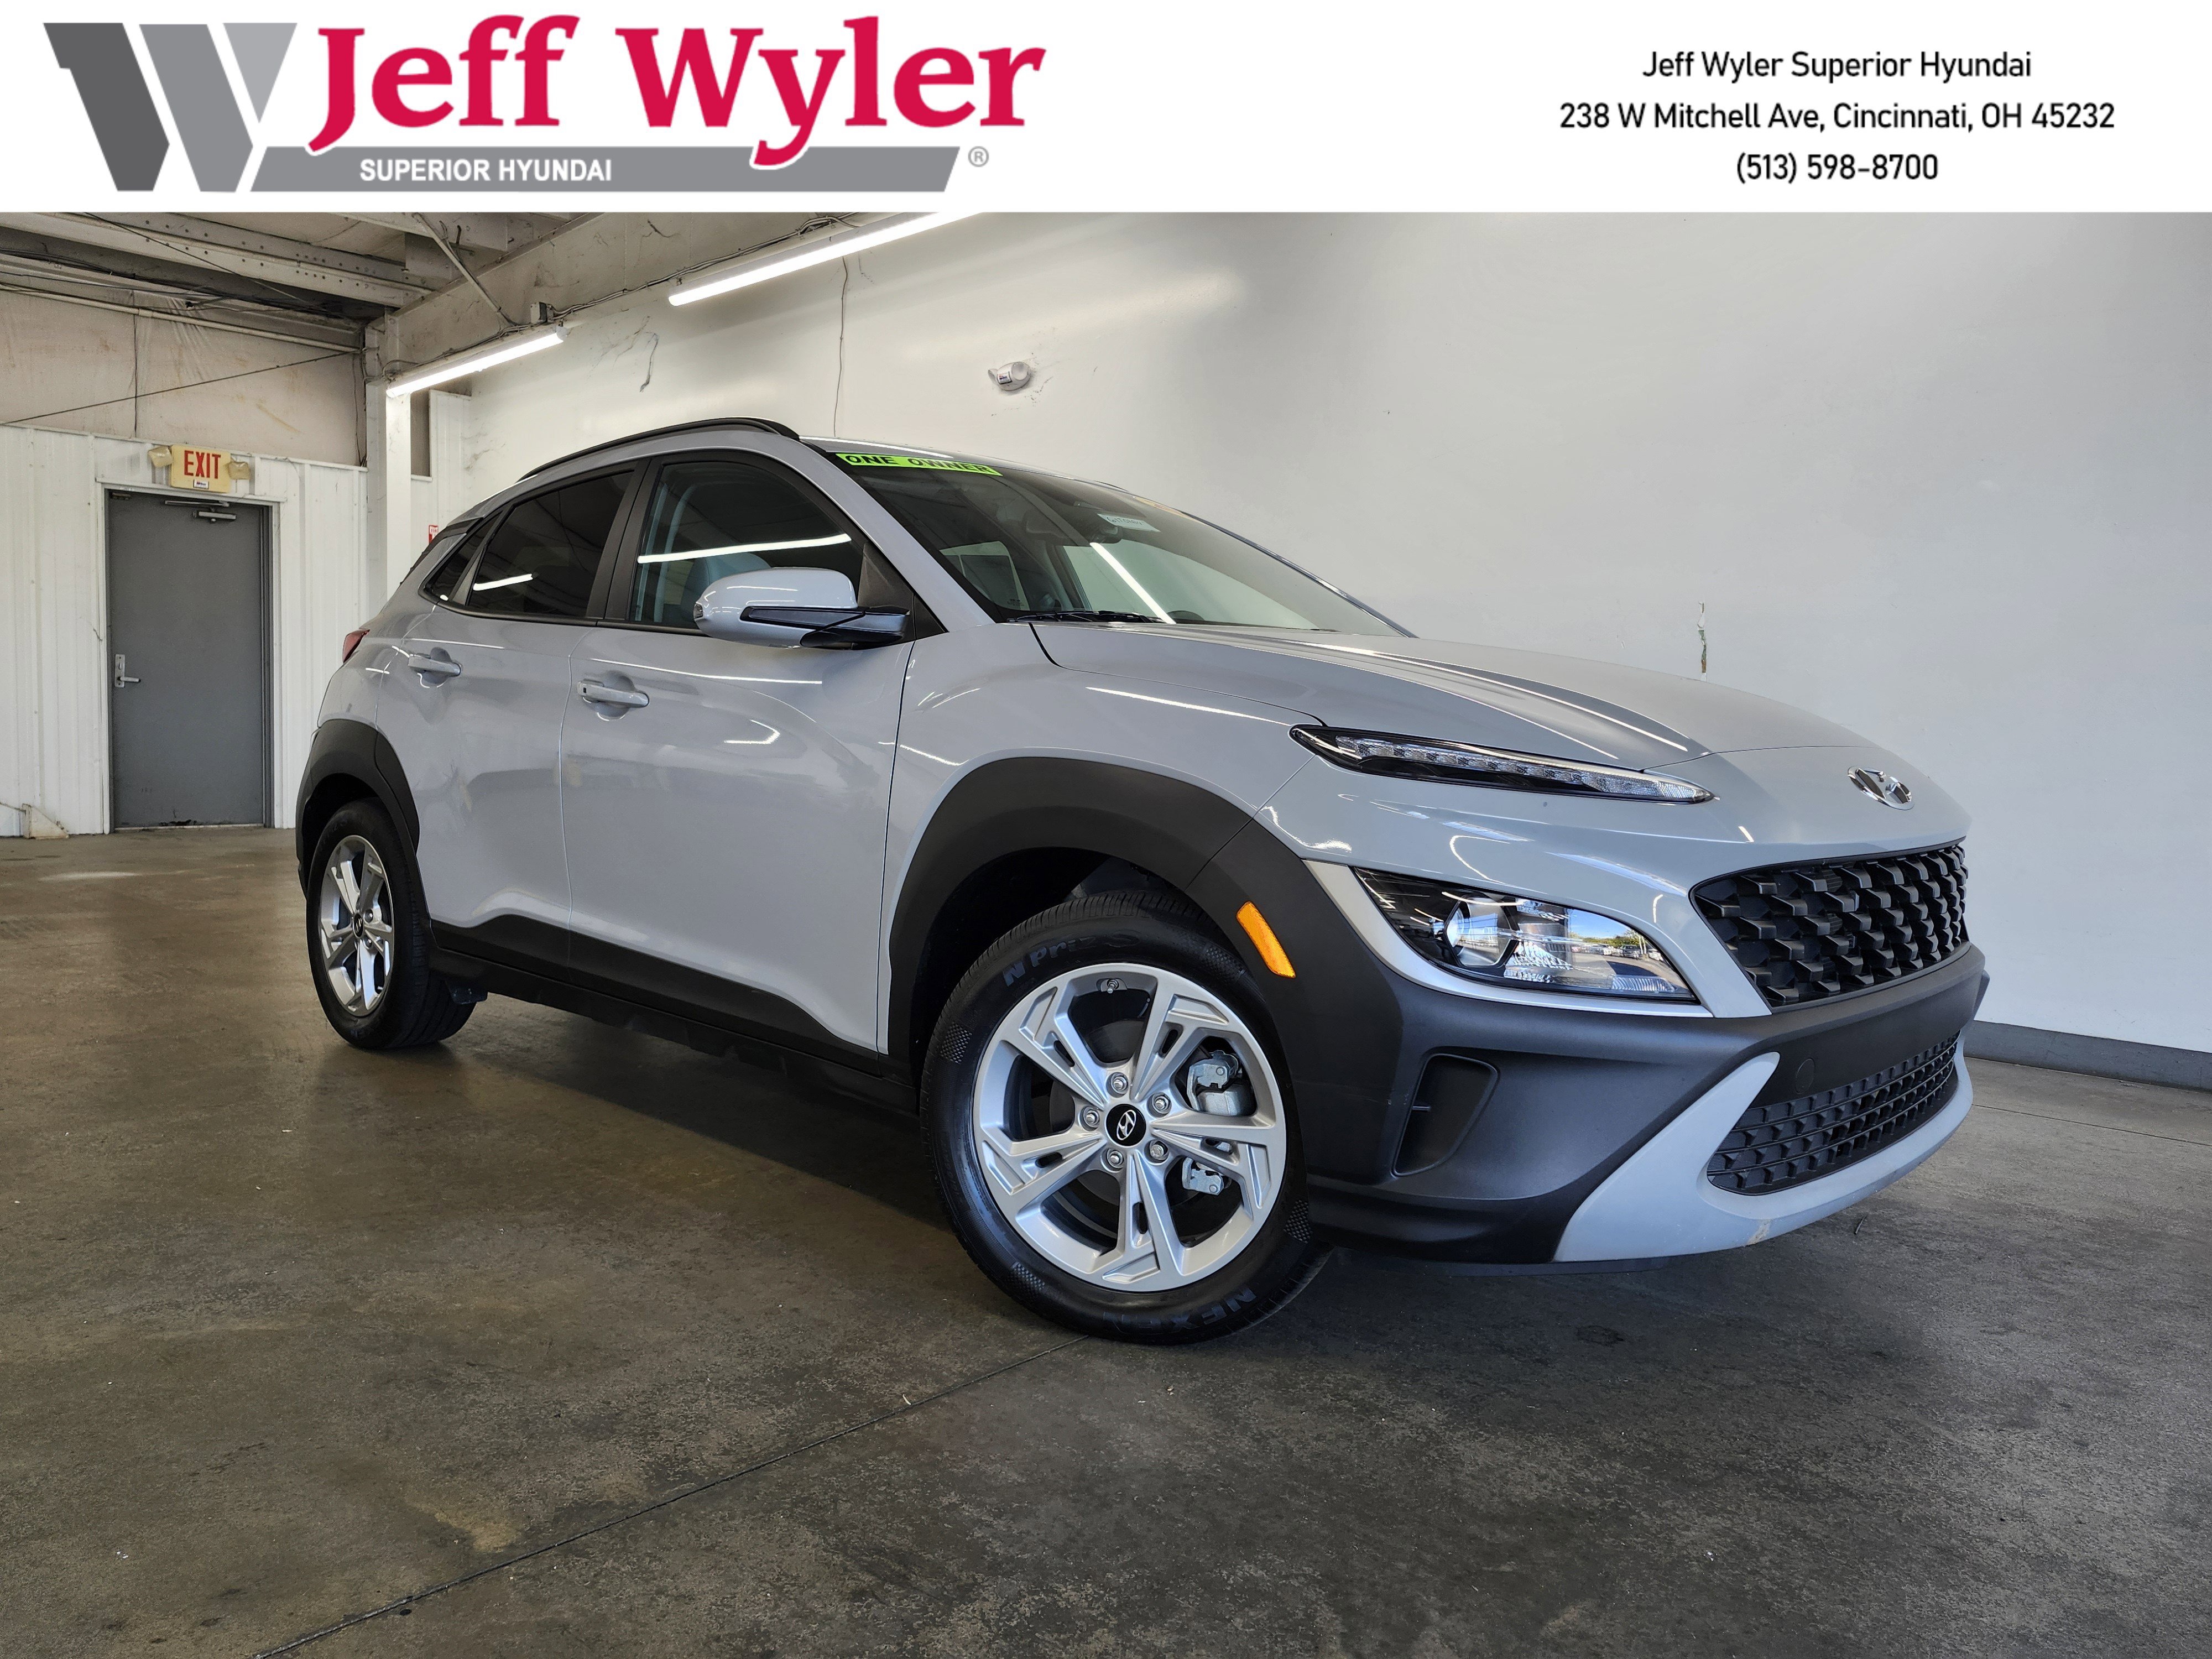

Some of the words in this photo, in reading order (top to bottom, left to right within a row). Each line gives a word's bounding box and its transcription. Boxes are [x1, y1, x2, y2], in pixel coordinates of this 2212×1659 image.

[184, 450, 221, 479] EXIT
[846, 455, 899, 465] ONE
[907, 457, 994, 474] OWNER
